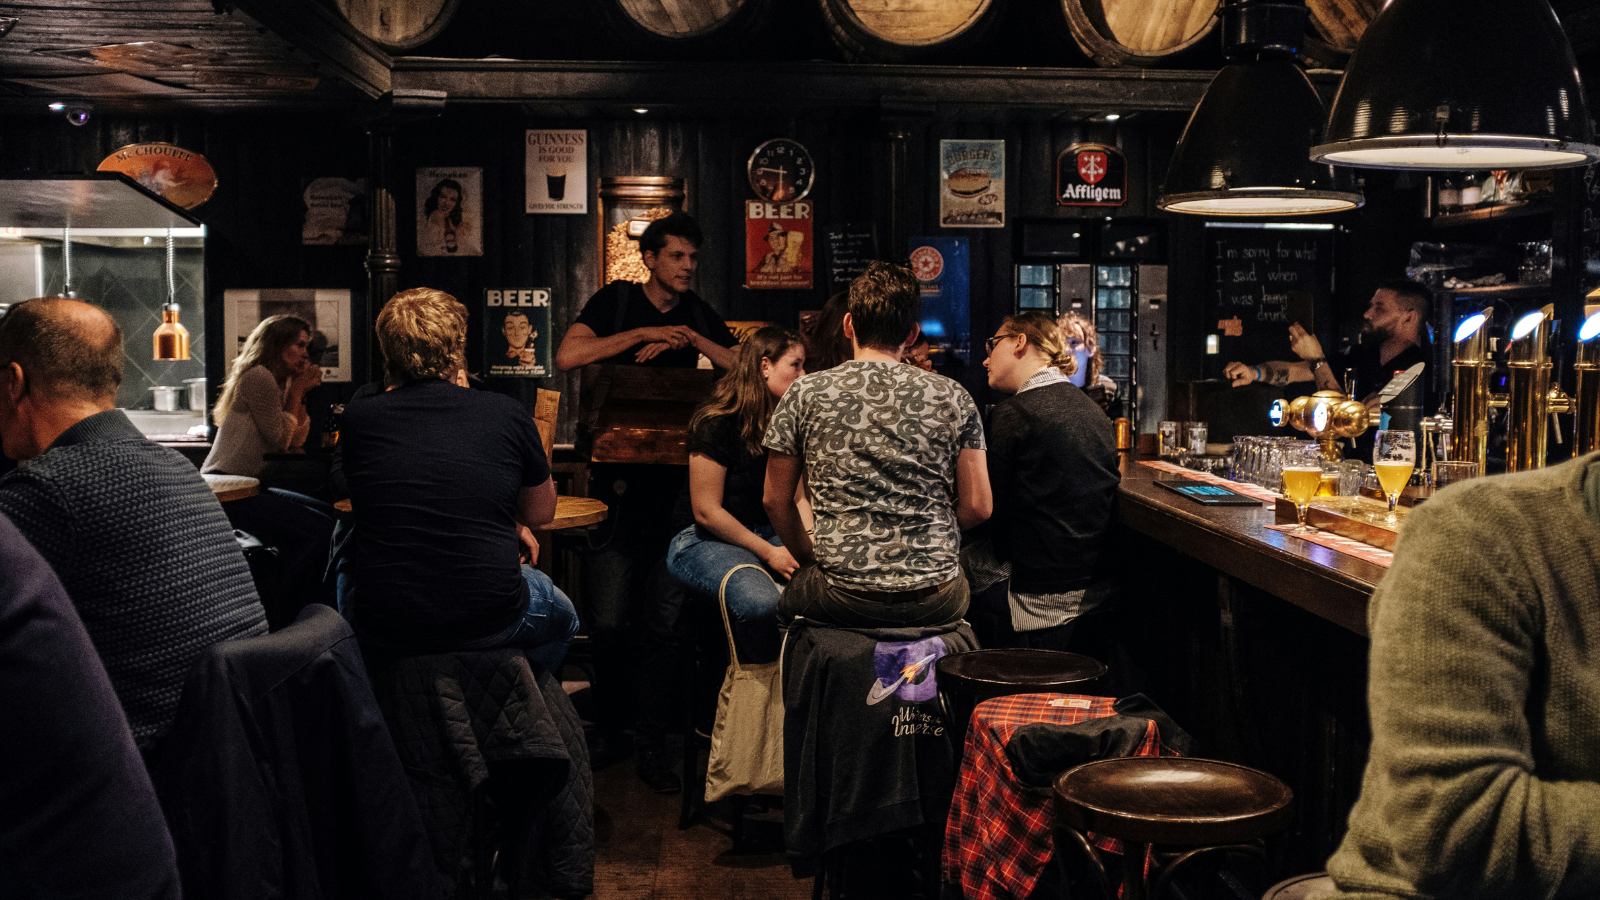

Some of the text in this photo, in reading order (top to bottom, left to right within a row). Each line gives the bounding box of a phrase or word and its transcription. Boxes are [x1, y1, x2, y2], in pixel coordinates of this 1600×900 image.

[528, 133, 584, 146] GUINNESS
[135, 146, 192, 161] CHOUFFE
[539, 146, 574, 154] IS GOOD
[948, 149, 998, 165] BURGERS
[539, 155, 574, 163] FOR YOU
[796, 157, 803, 165] 2
[799, 168, 806, 176] 3
[1062, 183, 1122, 202] Affligem
[749, 202, 810, 219] BEER
[1215, 240, 1238, 259] I'm
[1243, 248, 1270, 264] sorry
[1277, 240, 1292, 258] for
[1215, 263, 1298, 283] I said when
[487, 289, 549, 307] BEER
[1215, 289, 1223, 306] I
[1231, 295, 1254, 306] was
